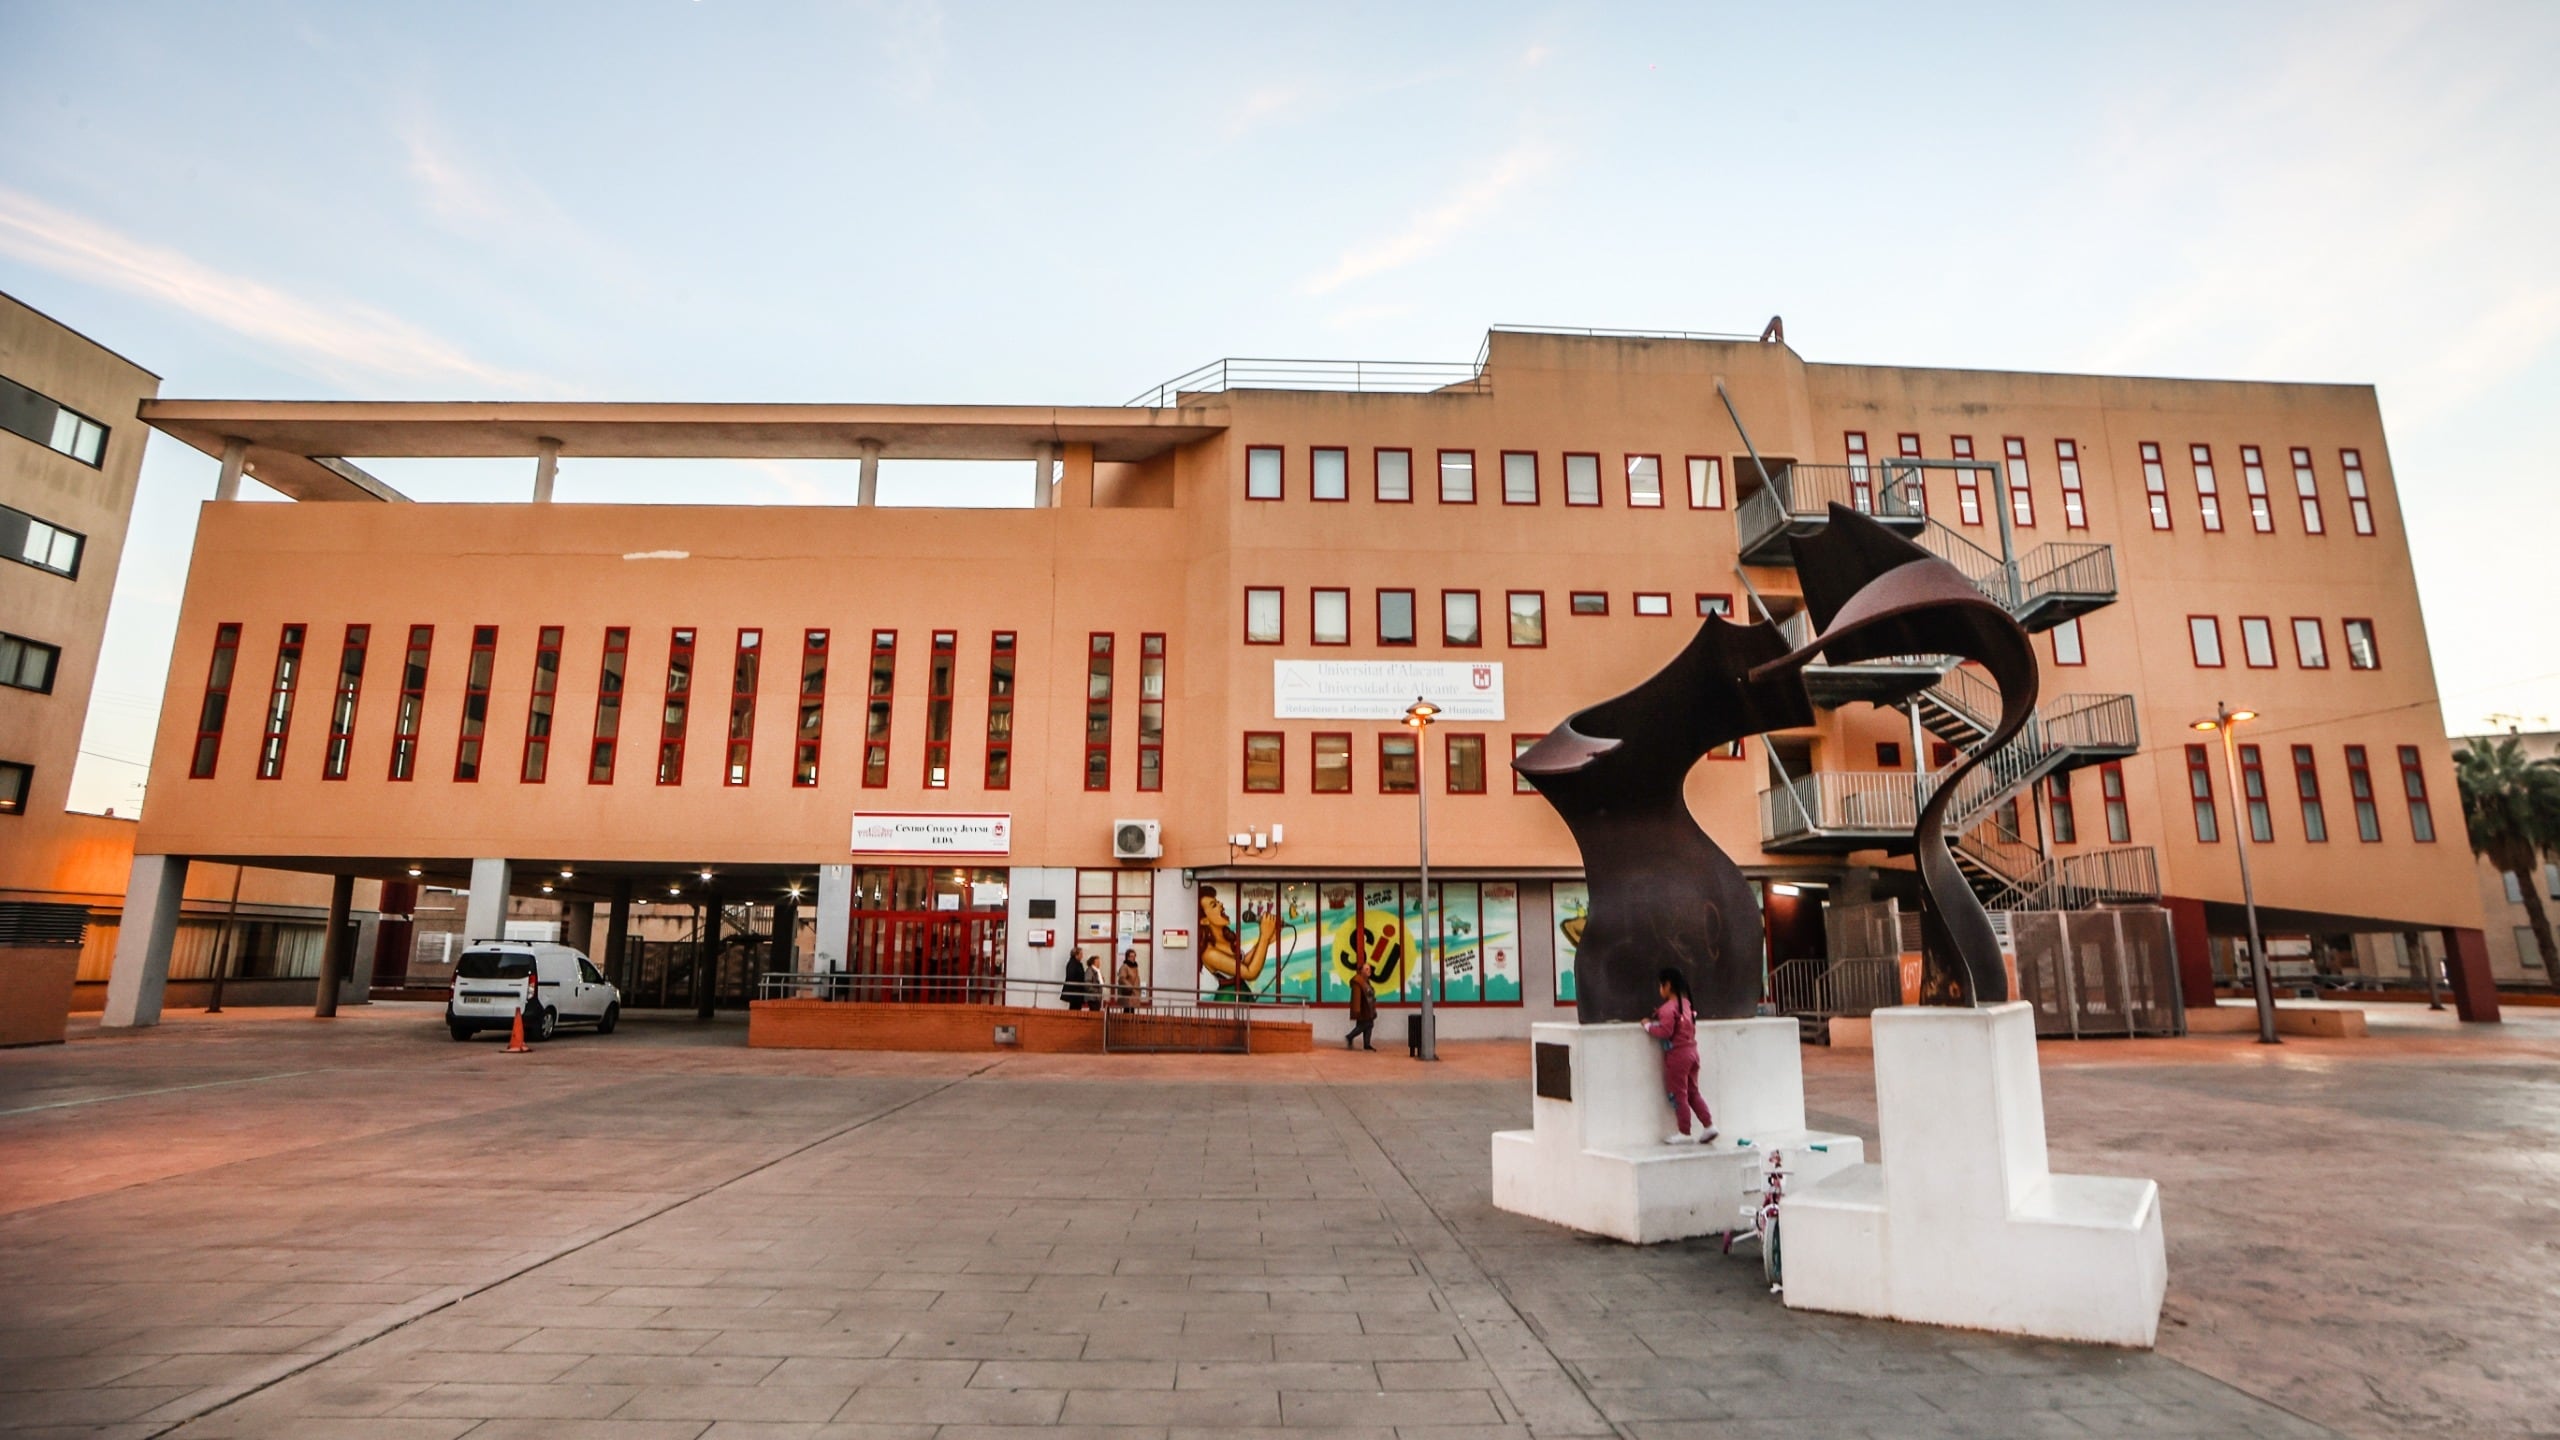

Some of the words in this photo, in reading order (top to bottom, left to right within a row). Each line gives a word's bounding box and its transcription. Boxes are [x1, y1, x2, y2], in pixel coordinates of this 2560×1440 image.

[1318, 664, 1384, 677] Universitat
[1387, 664, 1444, 678] d'Alacant
[1318, 681, 1390, 695] Universidad
[1393, 681, 1406, 695] de
[1411, 682, 1460, 696] Alicante
[1285, 703, 1338, 714] Relaciones
[1341, 704, 1390, 714] Laborales
